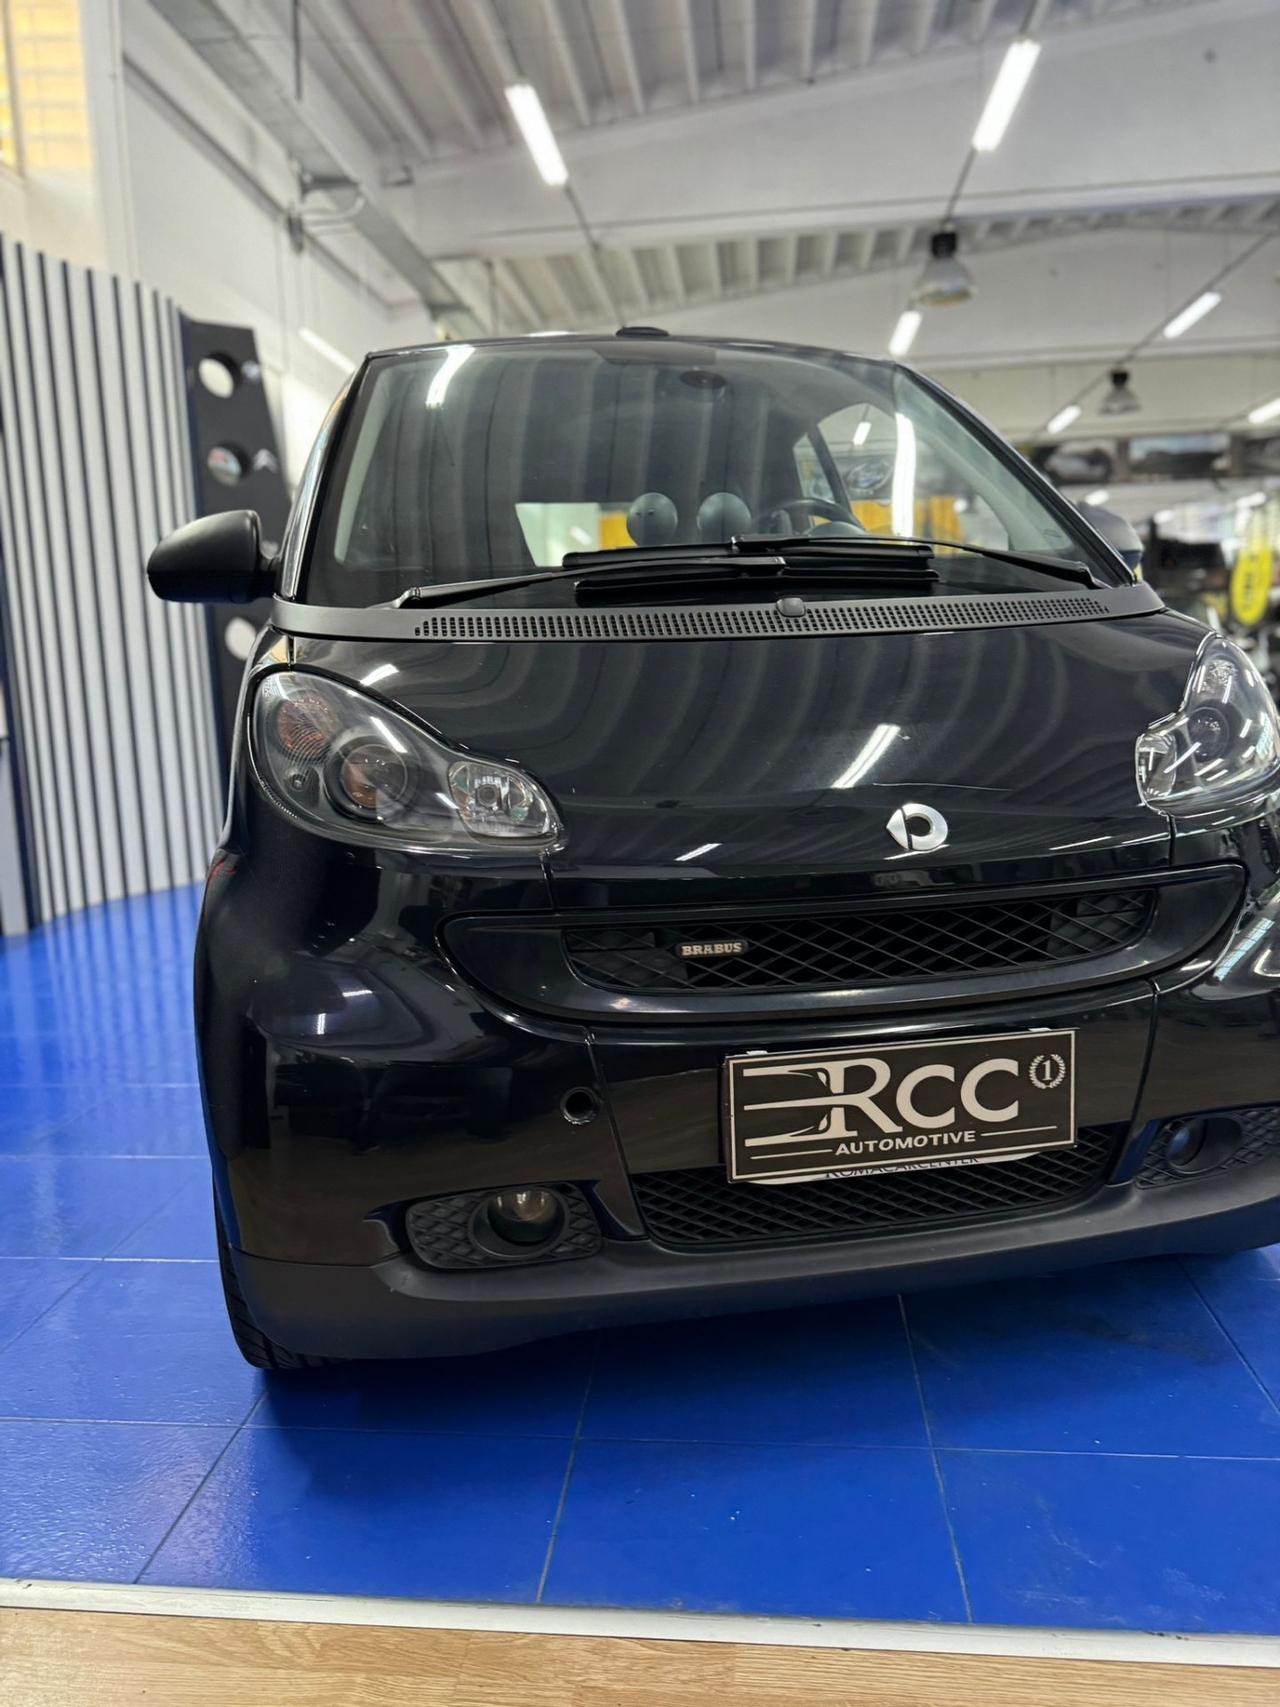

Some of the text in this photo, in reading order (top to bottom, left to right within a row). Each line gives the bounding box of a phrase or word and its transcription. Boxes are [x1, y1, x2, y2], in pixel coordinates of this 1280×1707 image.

[681, 942, 742, 956] BRABUS
[1042, 1060, 1053, 1081] 1
[835, 1131, 976, 1156] AUTOMOTIVE
